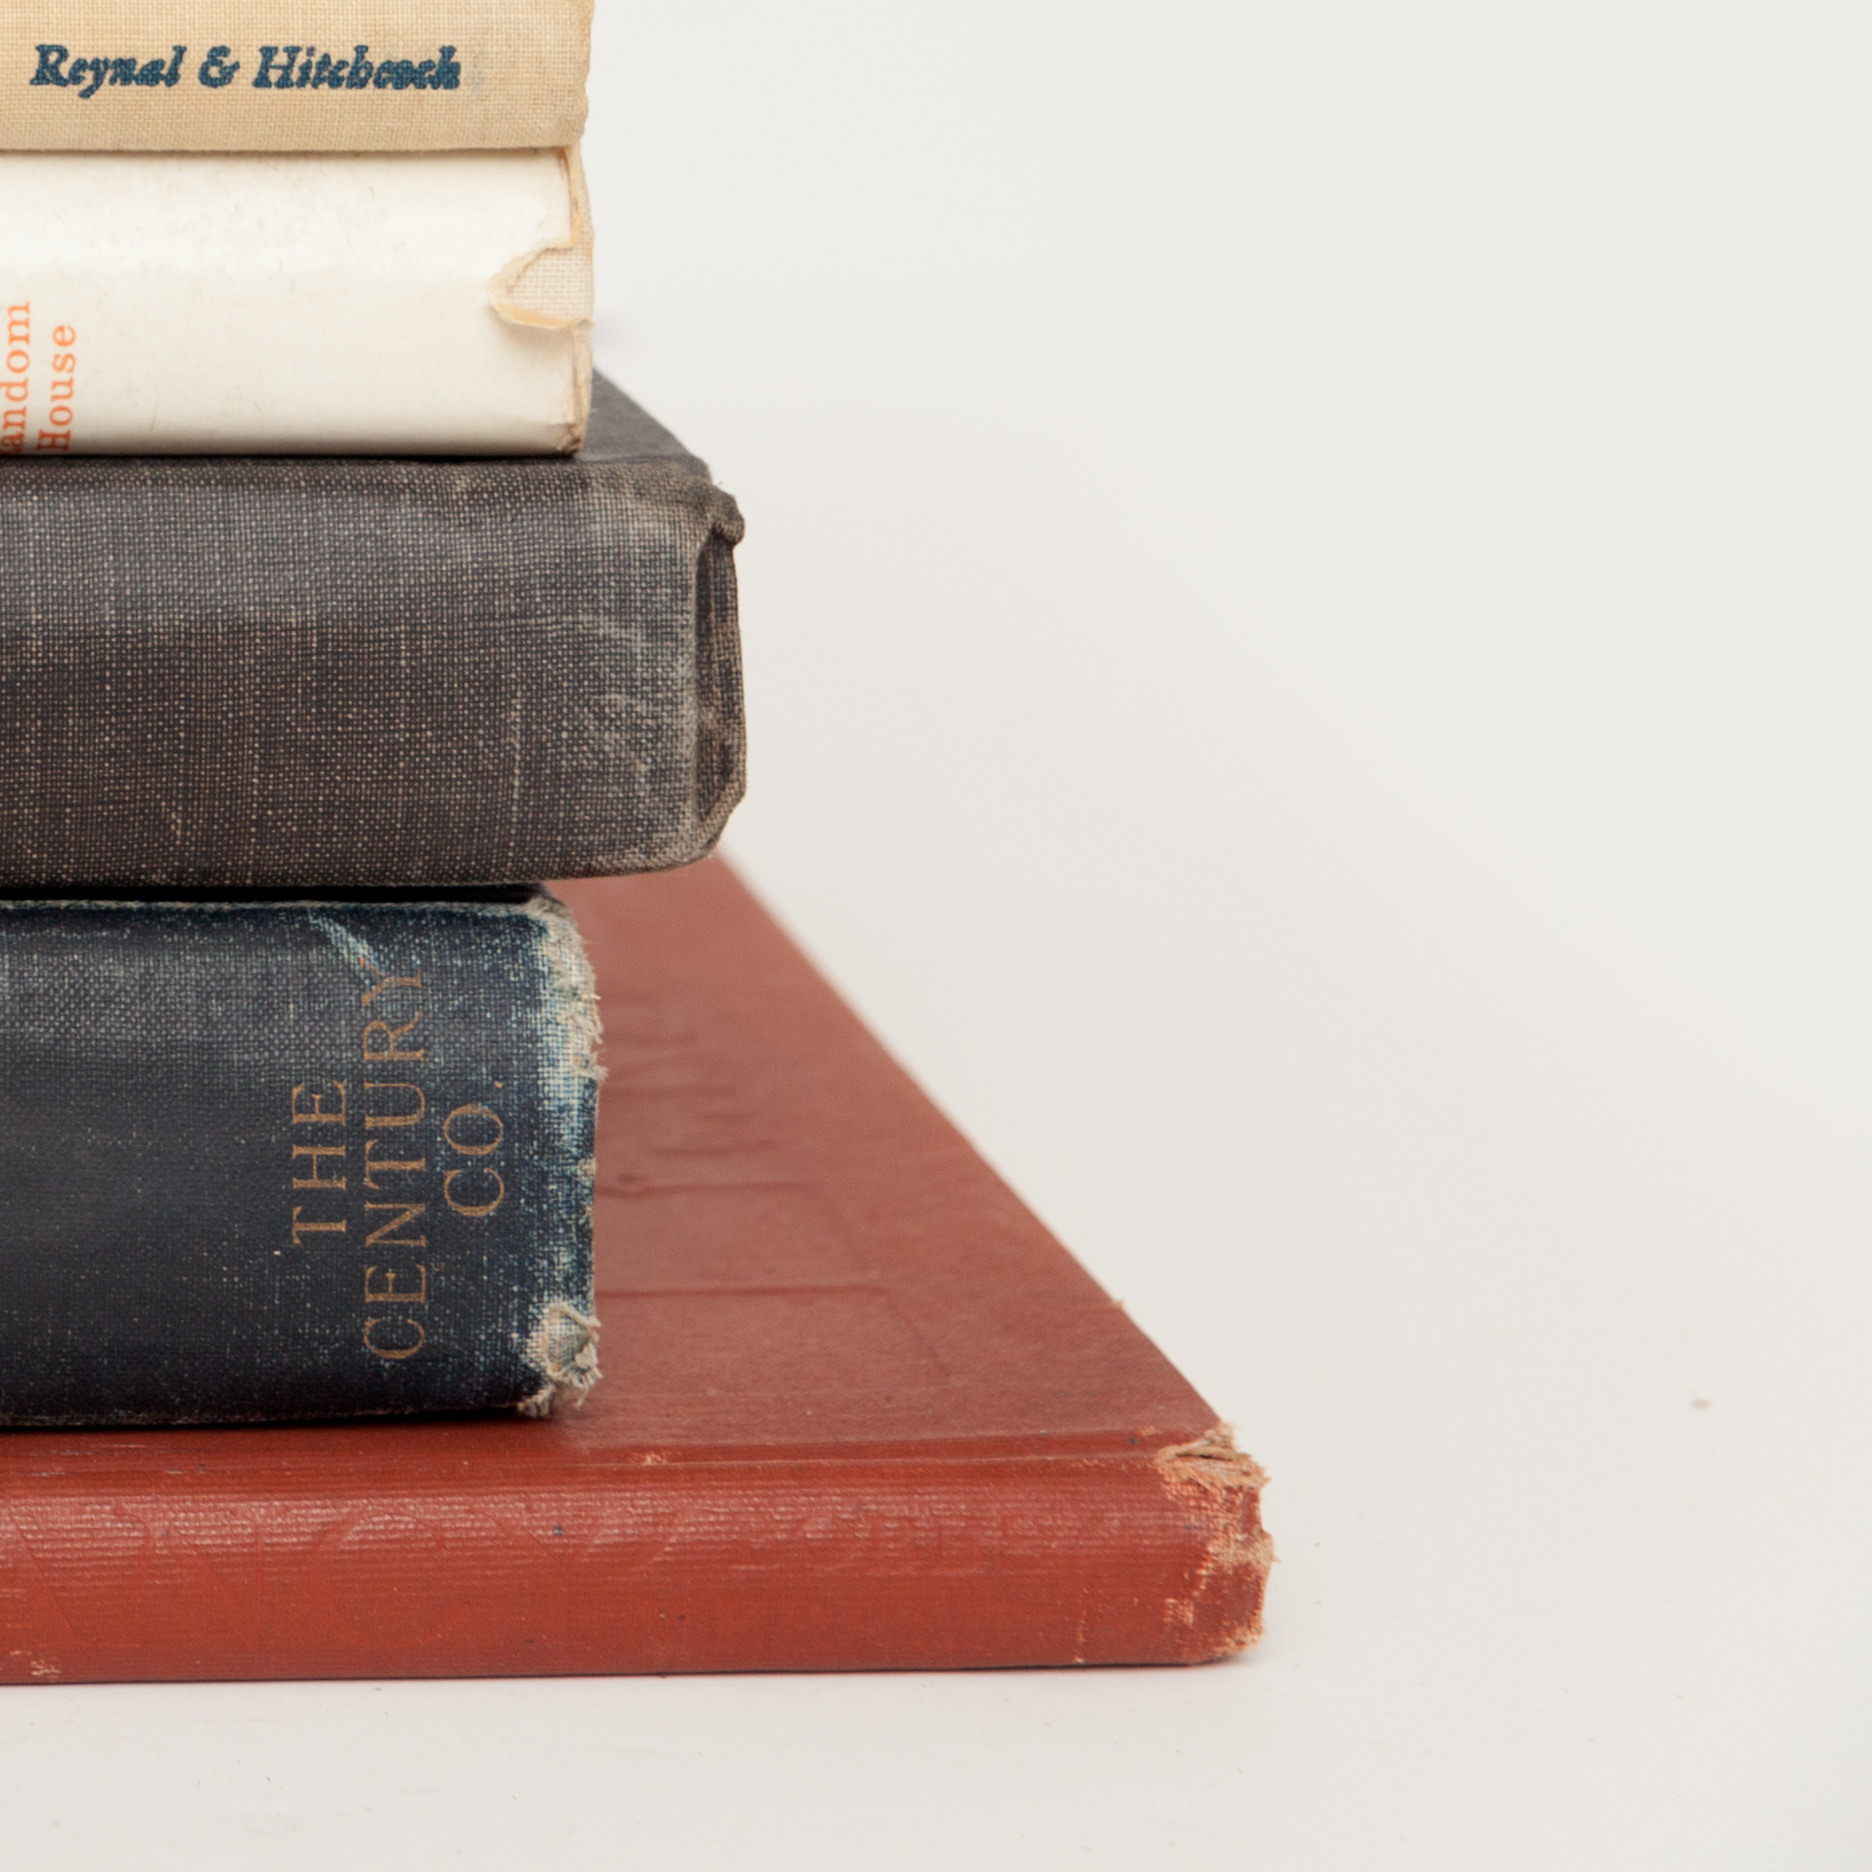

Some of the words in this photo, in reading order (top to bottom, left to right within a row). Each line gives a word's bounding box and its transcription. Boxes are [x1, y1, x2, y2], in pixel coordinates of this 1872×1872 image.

[29, 43, 187, 99] Reynal
[198, 45, 241, 90] &
[252, 45, 462, 90] Hitchcock
[37, 325, 76, 451] House
[290, 1079, 347, 1246] THE
[360, 955, 428, 1362] CENTURY
